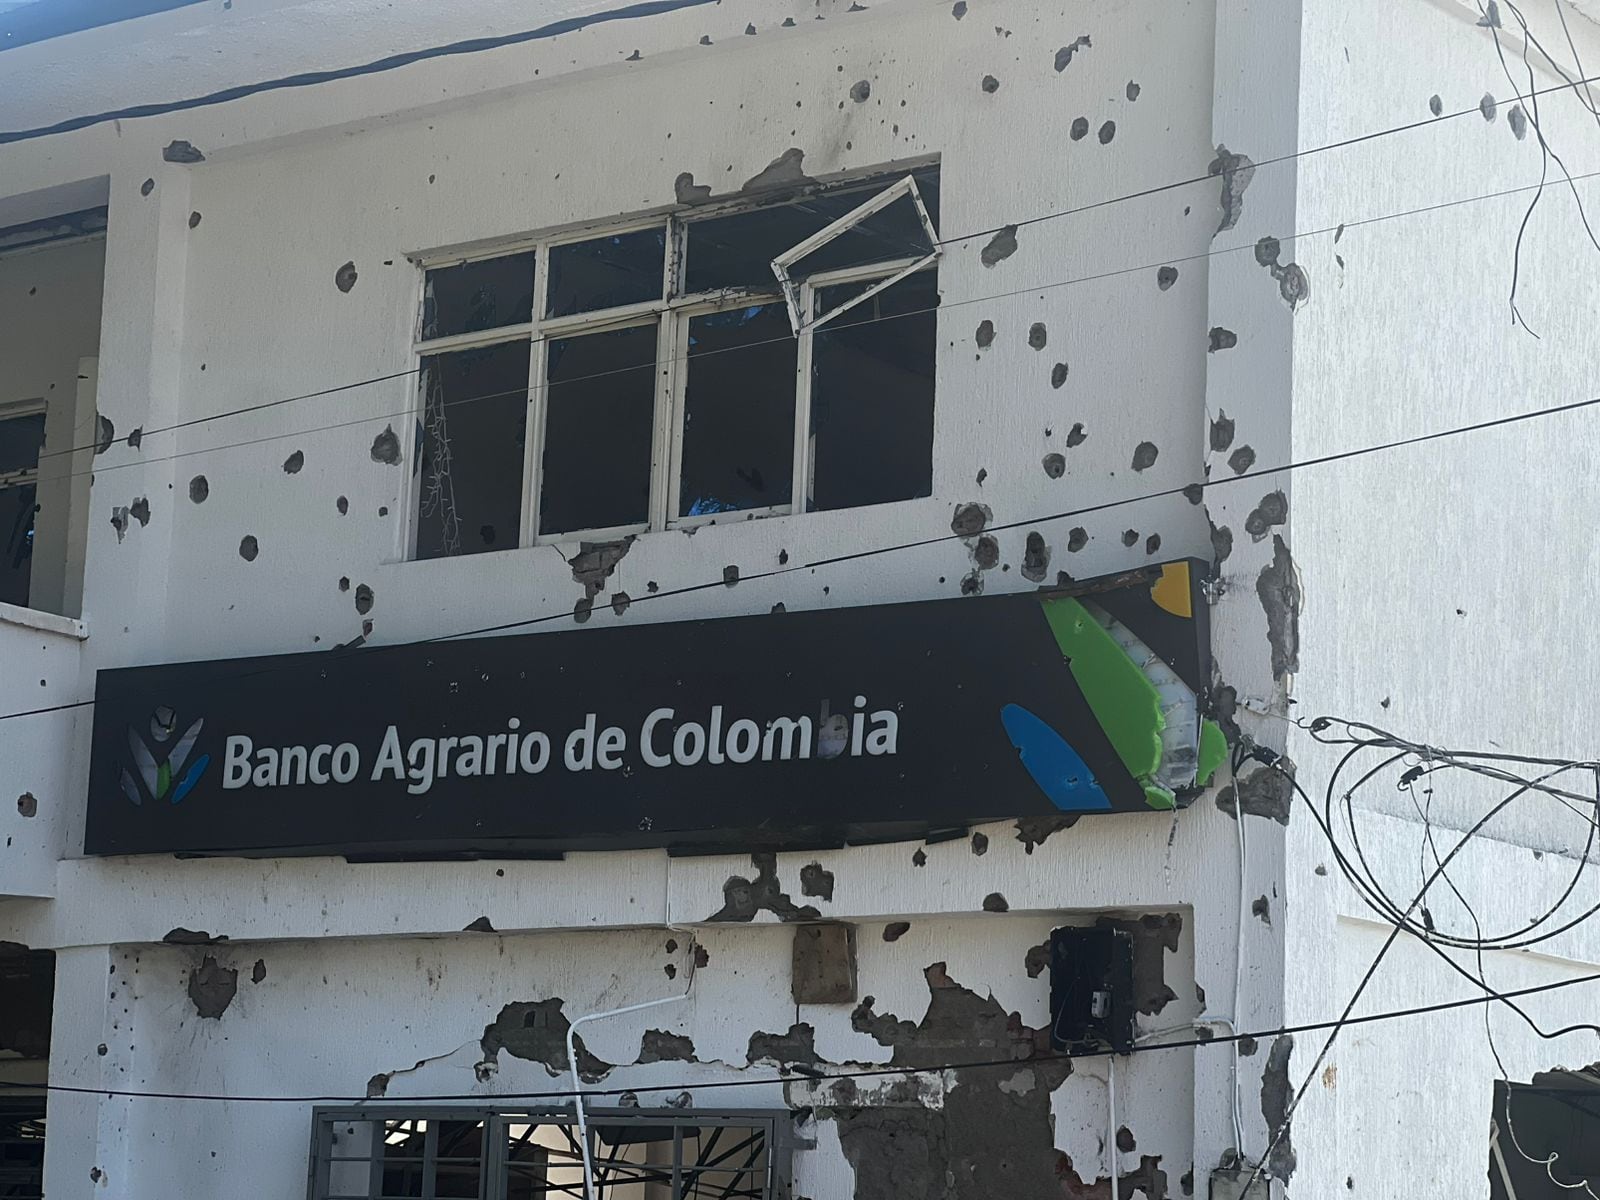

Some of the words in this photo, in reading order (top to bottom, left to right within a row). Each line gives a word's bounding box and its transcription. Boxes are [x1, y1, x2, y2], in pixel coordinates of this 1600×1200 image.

[222, 735, 359, 789] Banco
[371, 717, 551, 794] Agrario
[564, 713, 626, 771] de
[640, 695, 899, 768] Colombia
